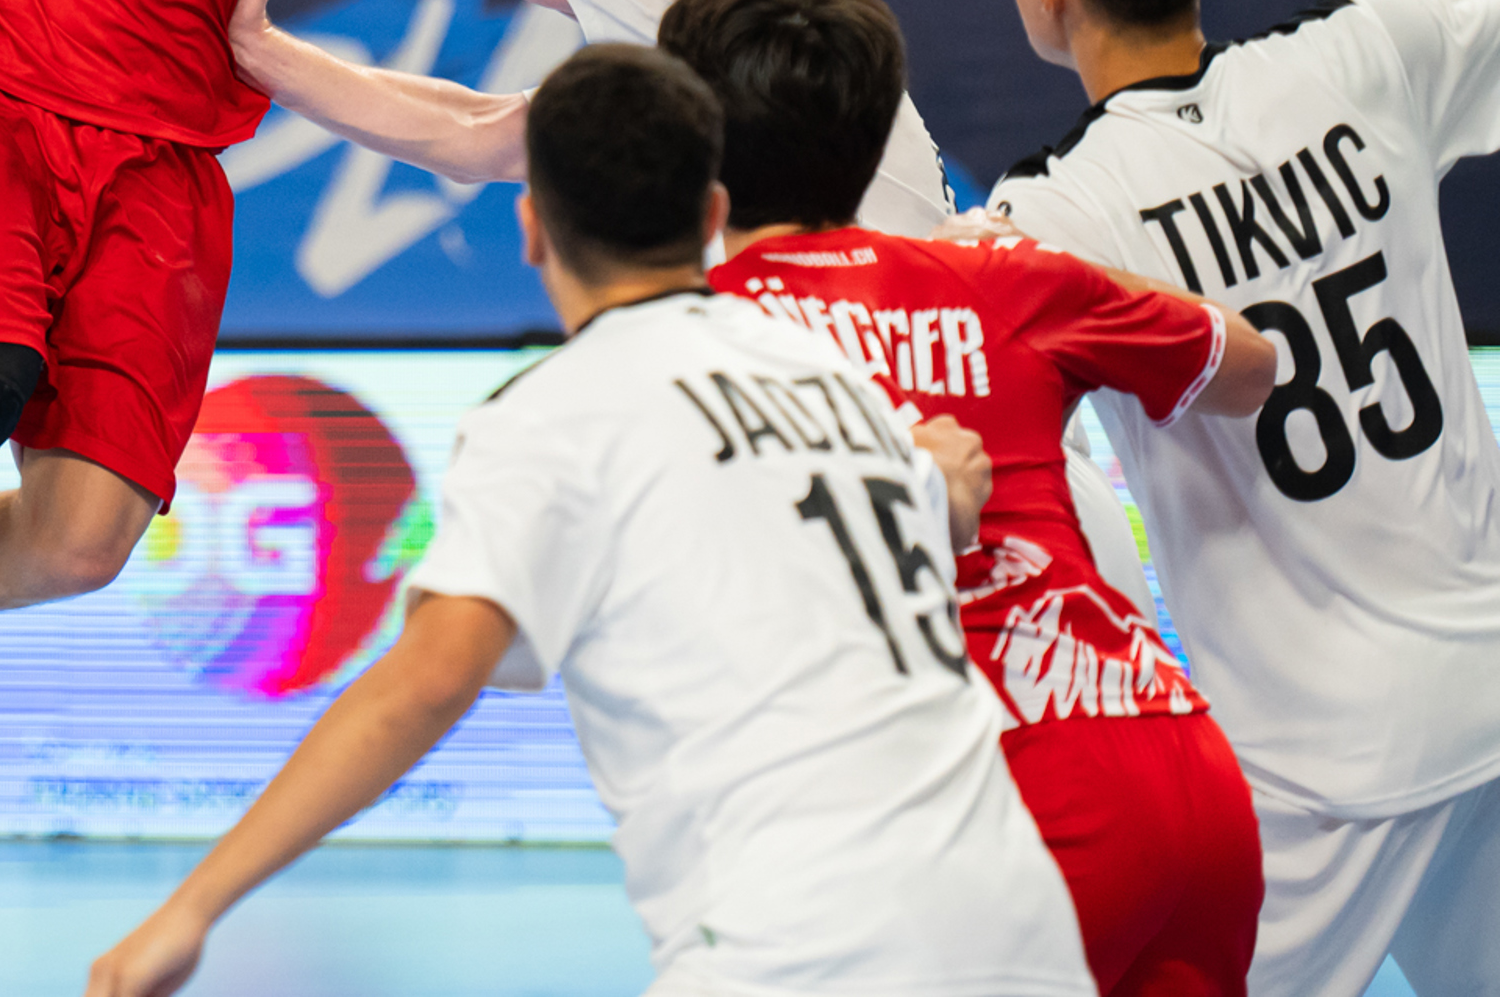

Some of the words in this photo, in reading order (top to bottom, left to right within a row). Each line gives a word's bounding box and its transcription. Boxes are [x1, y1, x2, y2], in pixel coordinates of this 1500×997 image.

[1139, 123, 1391, 296] TIKVIC
[1238, 250, 1443, 502] 85
[794, 473, 970, 683] 15
